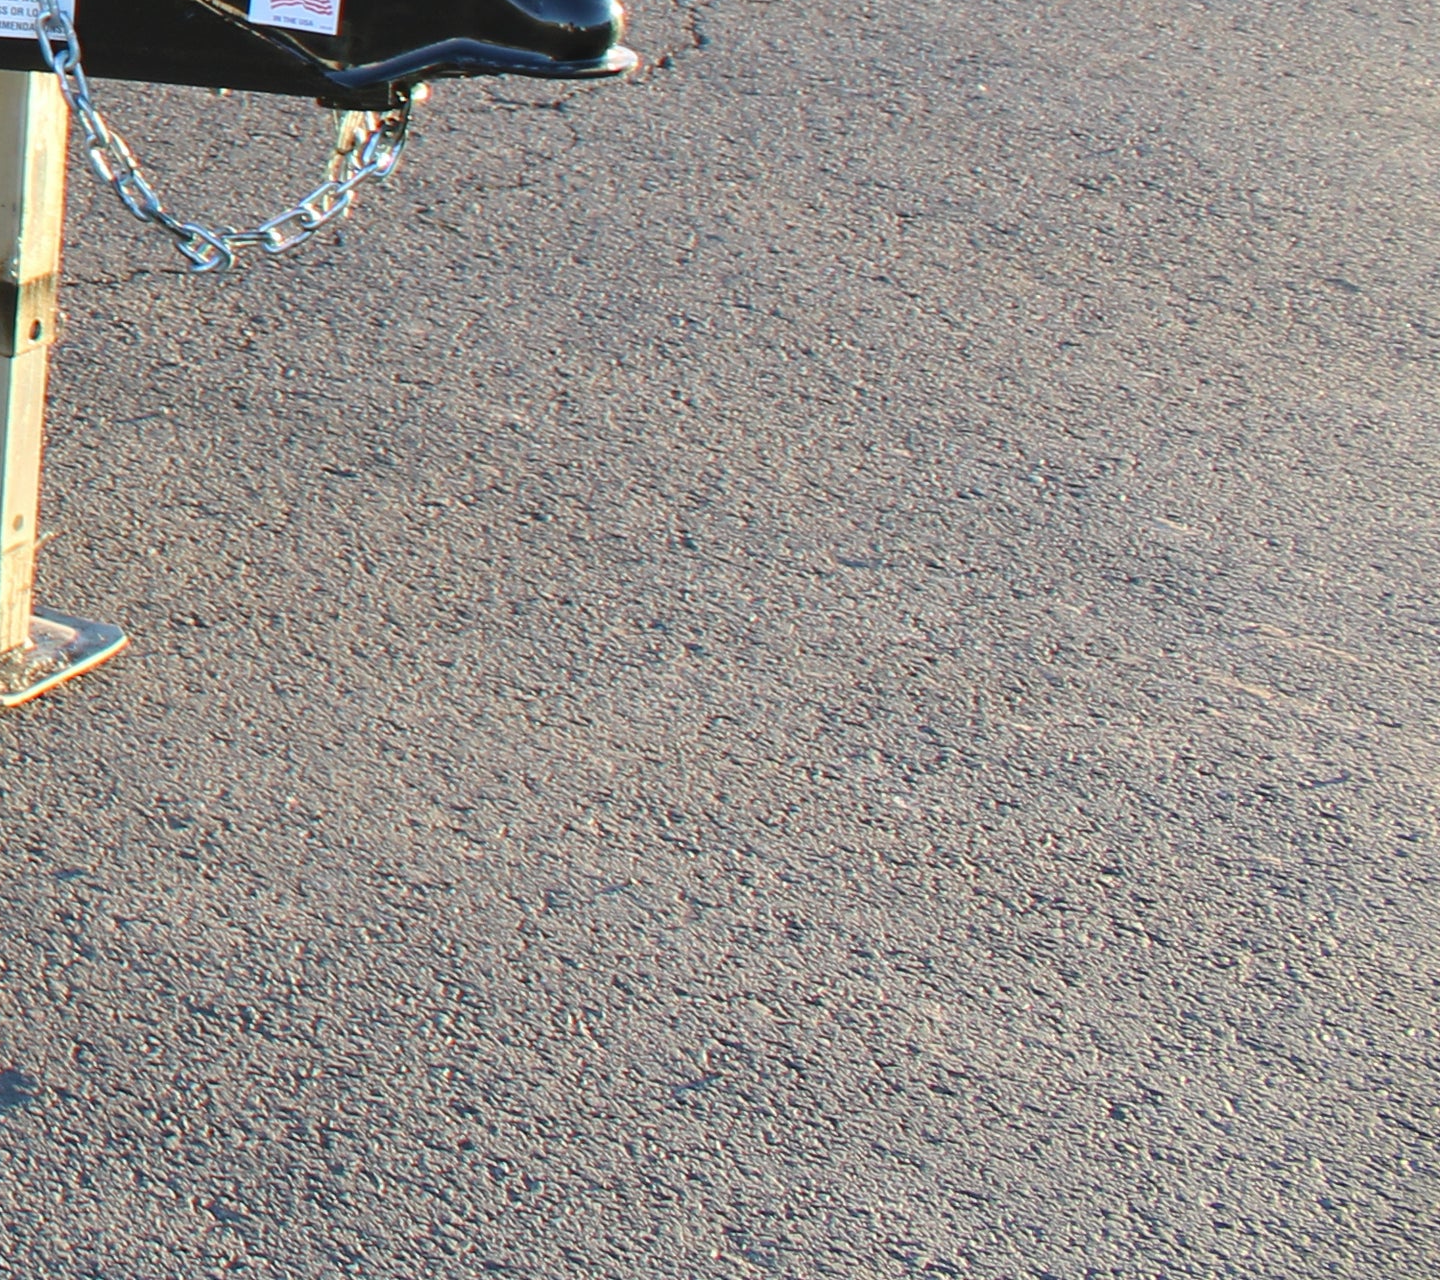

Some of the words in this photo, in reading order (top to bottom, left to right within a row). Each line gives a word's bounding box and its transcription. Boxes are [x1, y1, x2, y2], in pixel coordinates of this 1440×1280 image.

[10, 6, 24, 16] OR
[283, 16, 297, 24] THE
[298, 17, 314, 27] USA
